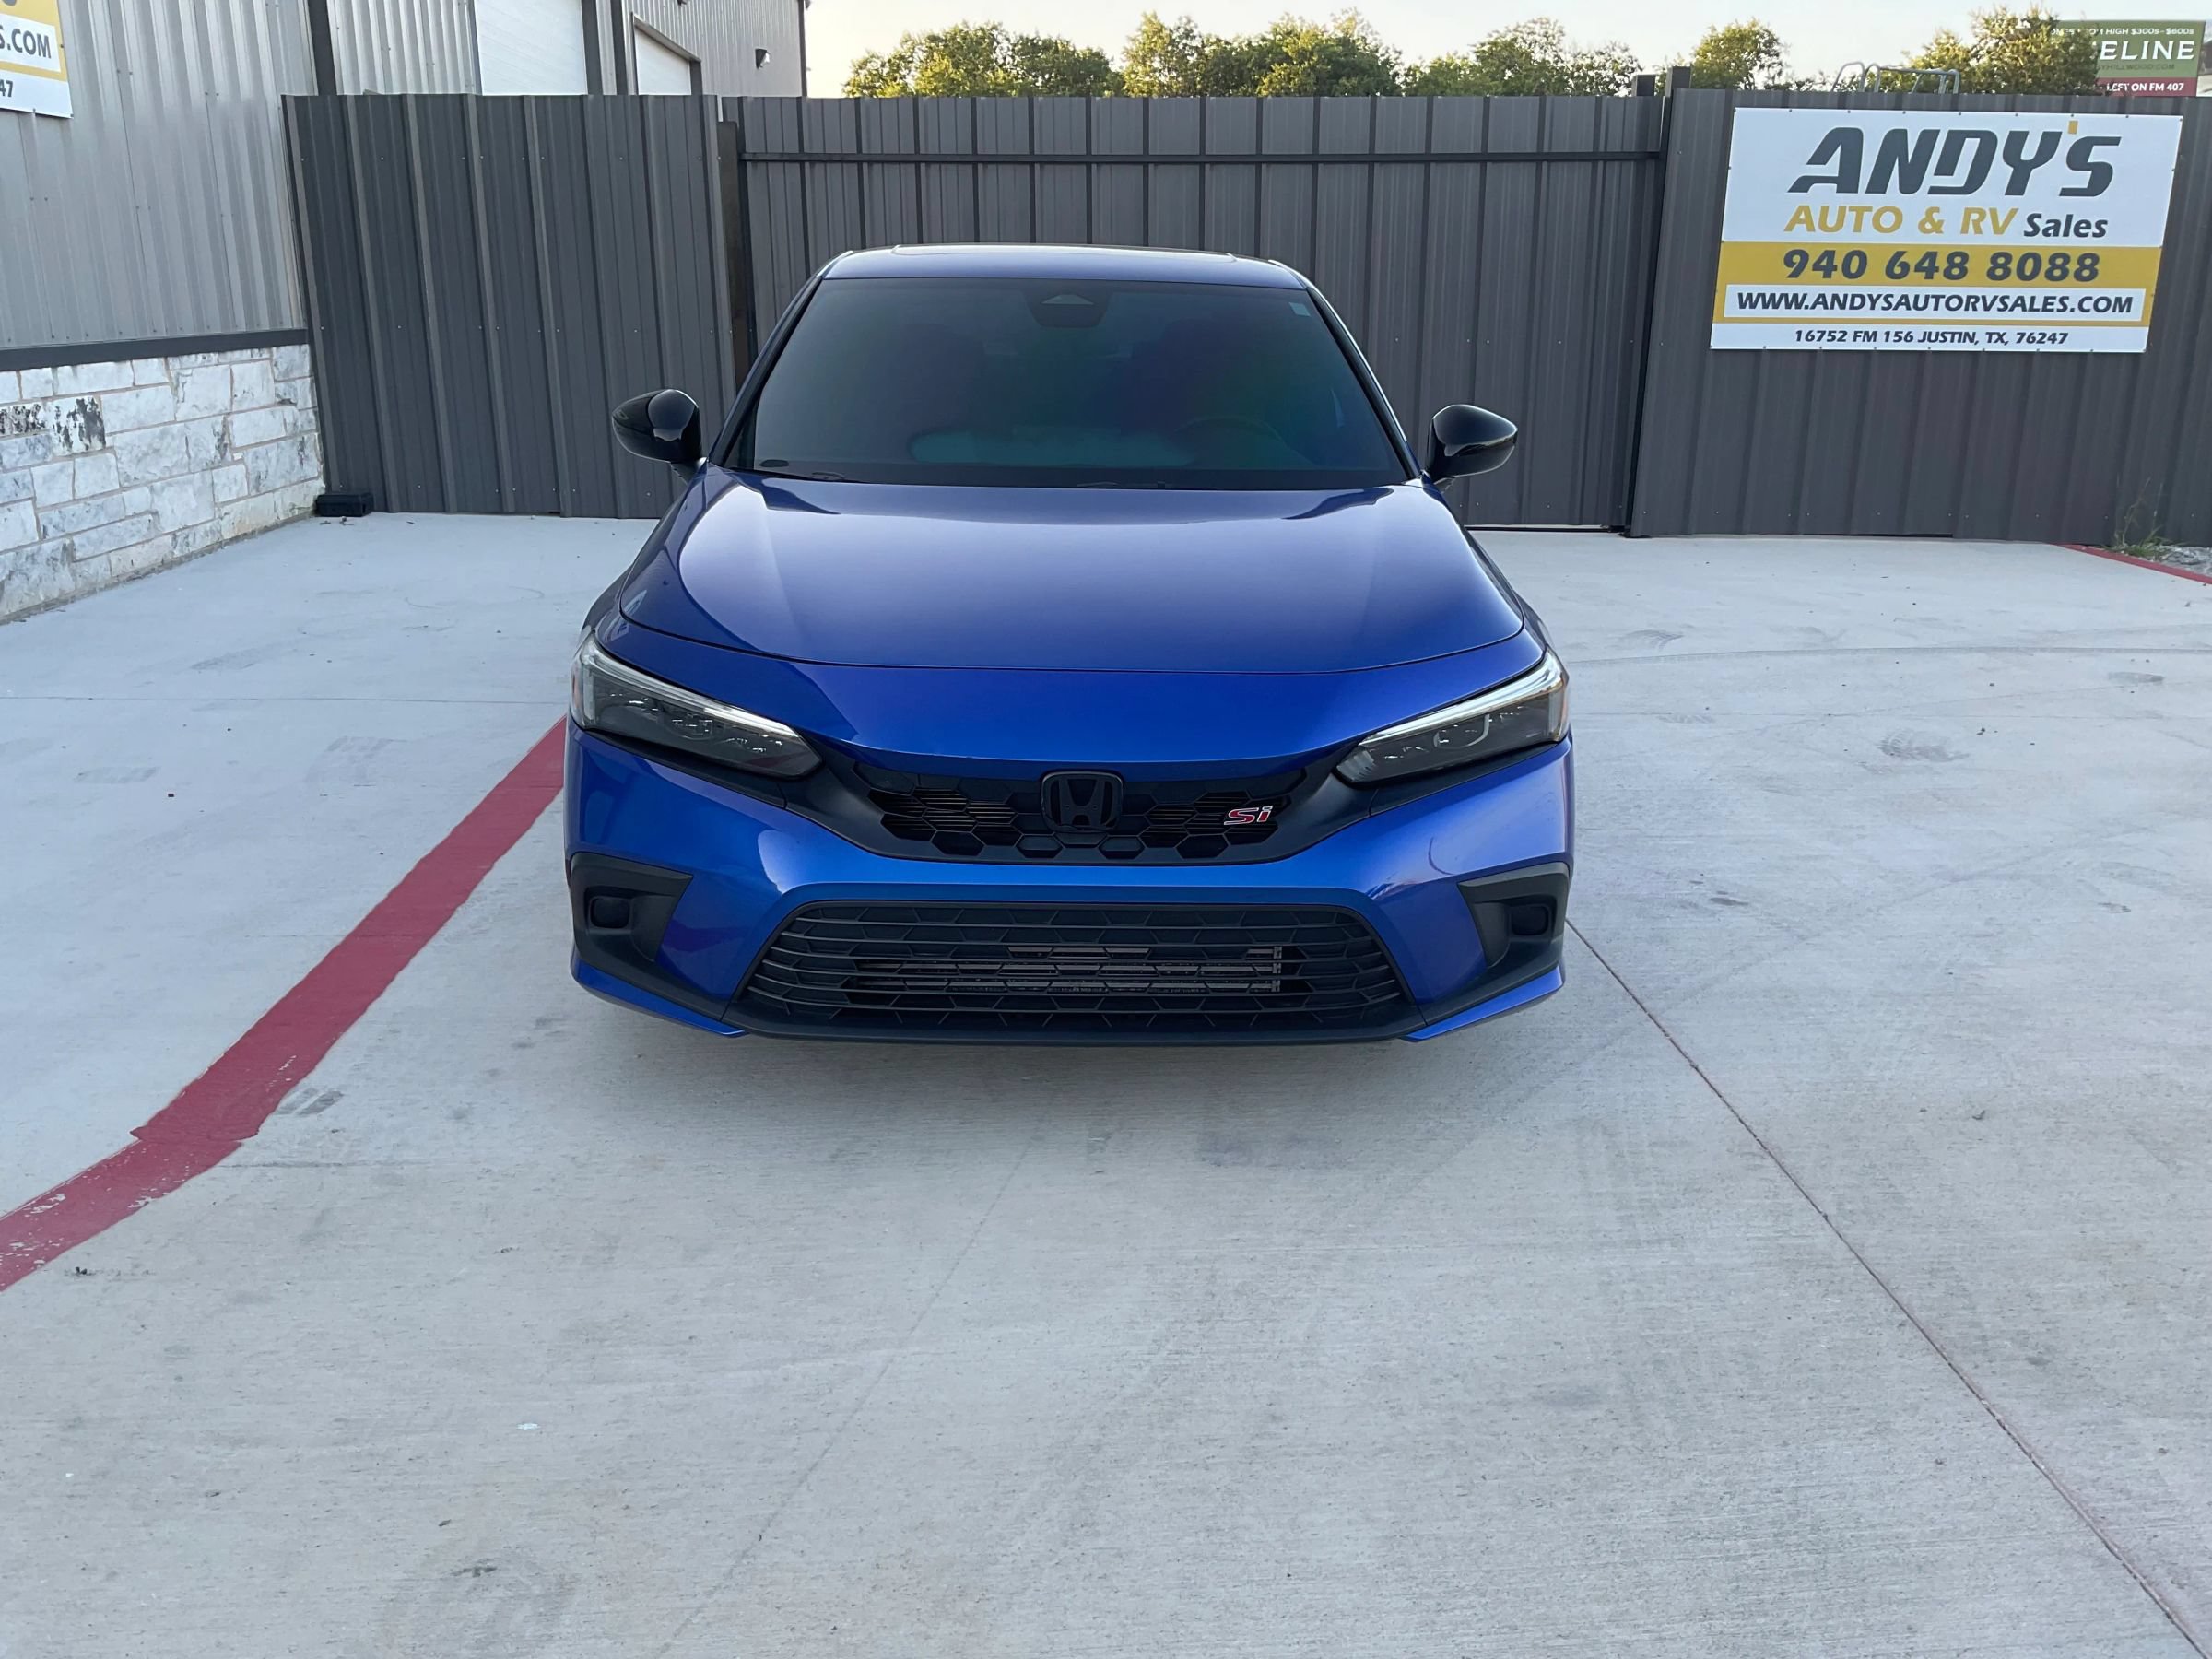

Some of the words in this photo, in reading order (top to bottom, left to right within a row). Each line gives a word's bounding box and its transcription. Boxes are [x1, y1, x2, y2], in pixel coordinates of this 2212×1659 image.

[2130, 82, 2147, 91] ON
[2148, 82, 2165, 91] FM
[2166, 82, 2185, 91] 407
[1787, 120, 2122, 197] ANDY'S
[1783, 205, 1904, 234] AUTO
[1917, 206, 1945, 234] &
[1959, 206, 2019, 235] RV
[2023, 213, 2109, 238] Sales
[1783, 248, 1868, 279] 940
[1885, 250, 1971, 281] 648
[1986, 251, 2100, 282] 8088
[1737, 292, 2134, 314] WWW.ANDYSAUTORVSALES.COM
[1795, 329, 1848, 343] 16752
[1853, 330, 1877, 343] FM
[1884, 330, 1914, 343] 156
[1917, 330, 1980, 346] JUSTIN,
[1985, 331, 2009, 346] TX,
[2016, 332, 2069, 345] 76247
[1224, 806, 1273, 825] Si
